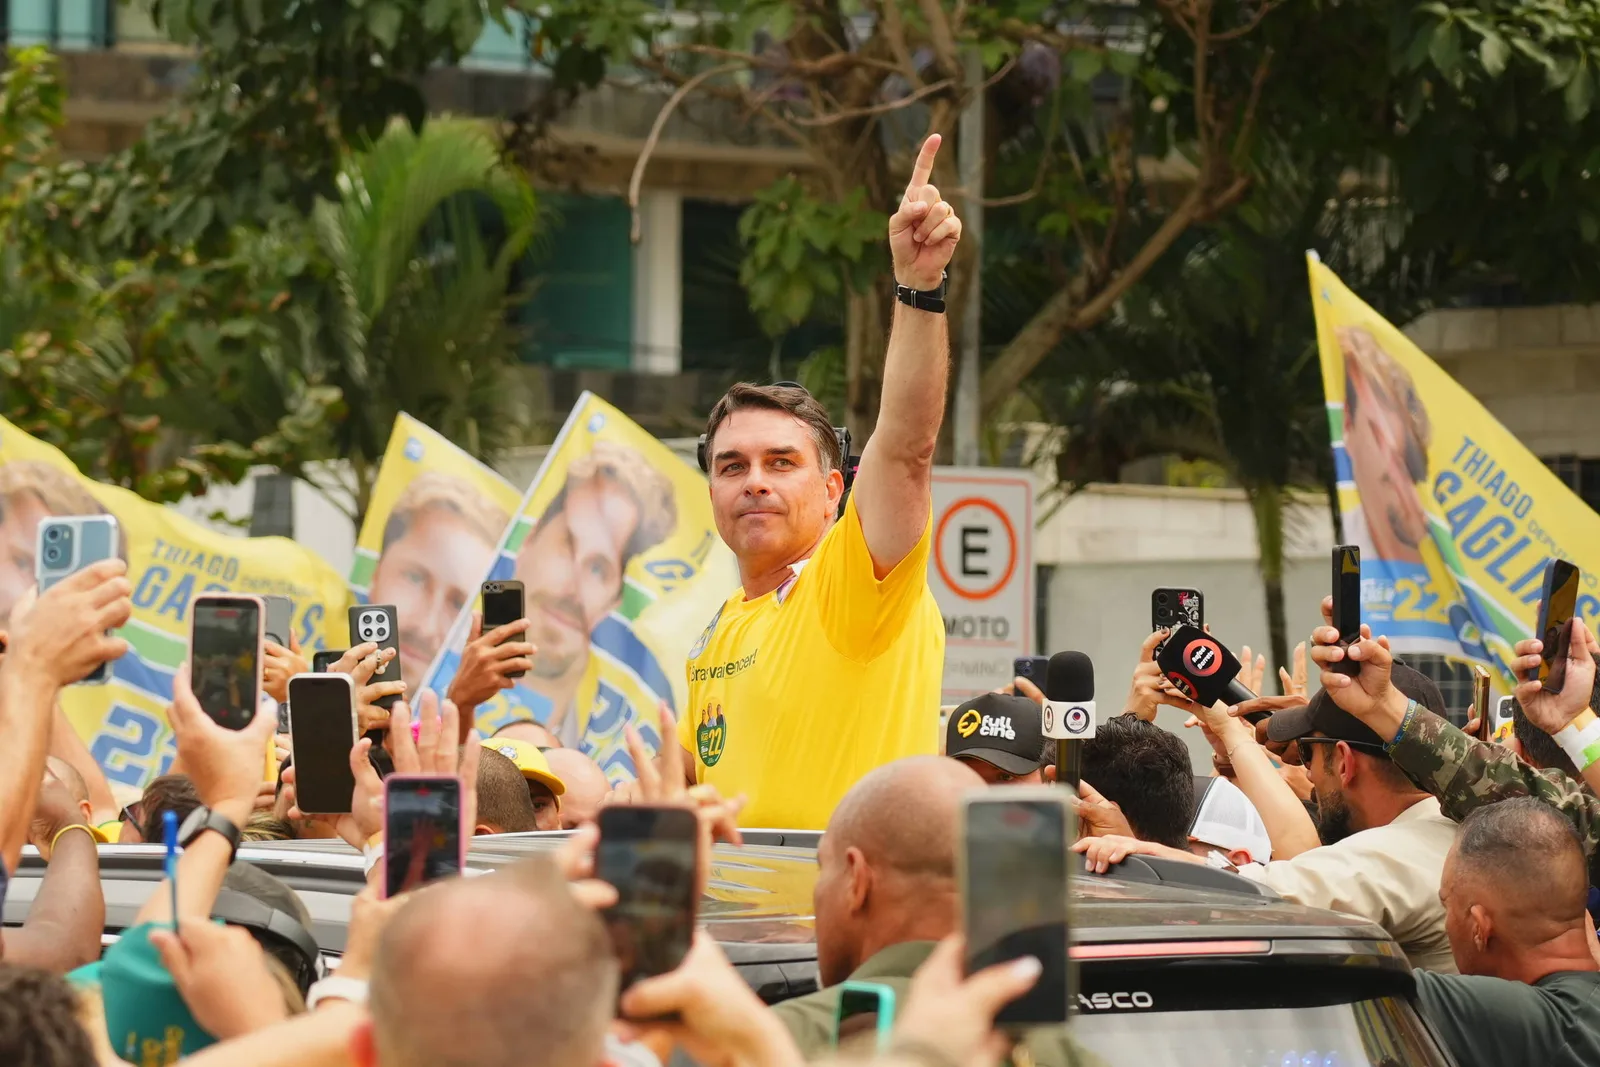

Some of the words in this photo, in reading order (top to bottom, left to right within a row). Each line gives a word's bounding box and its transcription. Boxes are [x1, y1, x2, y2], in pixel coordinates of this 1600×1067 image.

[1452, 435, 1534, 520] THIAGO
[151, 538, 239, 582] THIAGO
[961, 526, 989, 576] E
[1433, 469, 1600, 636] GAGLIS
[726, 648, 758, 675] encer!
[708, 727, 722, 757] 22
[1068, 991, 1154, 1010] ASCO
